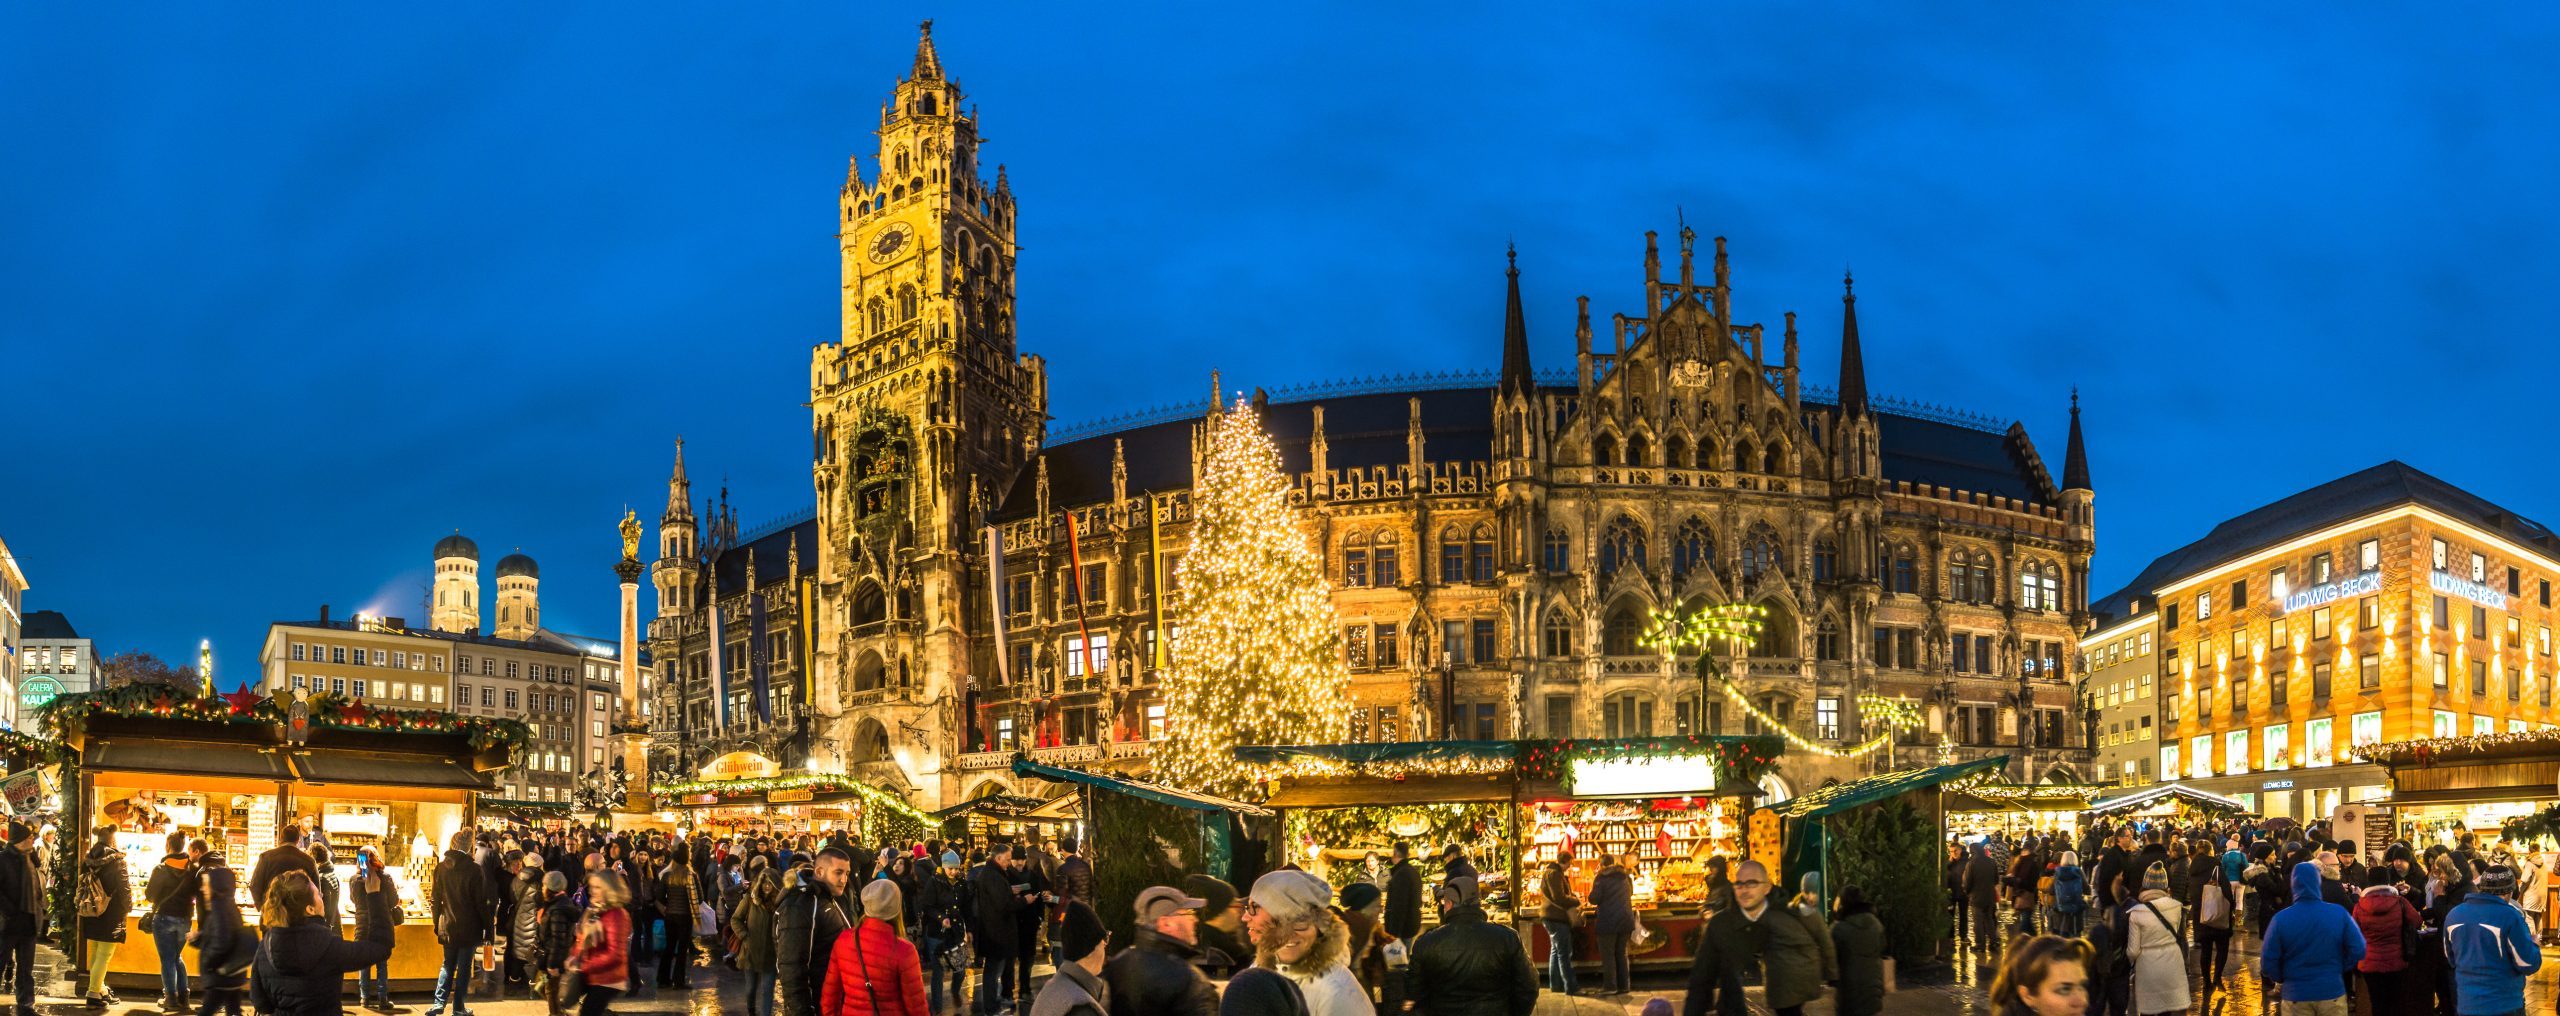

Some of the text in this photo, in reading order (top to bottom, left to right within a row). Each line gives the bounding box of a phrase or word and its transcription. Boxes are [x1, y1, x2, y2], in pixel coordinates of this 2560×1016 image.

[2284, 572, 2381, 613] LUDWIG BECK
[2431, 571, 2508, 610] LUDWIG BECK
[28, 683, 54, 692] GALERIA
[716, 759, 763, 774] Glühwein
[2281, 780, 2294, 788] BECK
[768, 790, 812, 801] Glühwein
[813, 810, 841, 819] Glühwein
